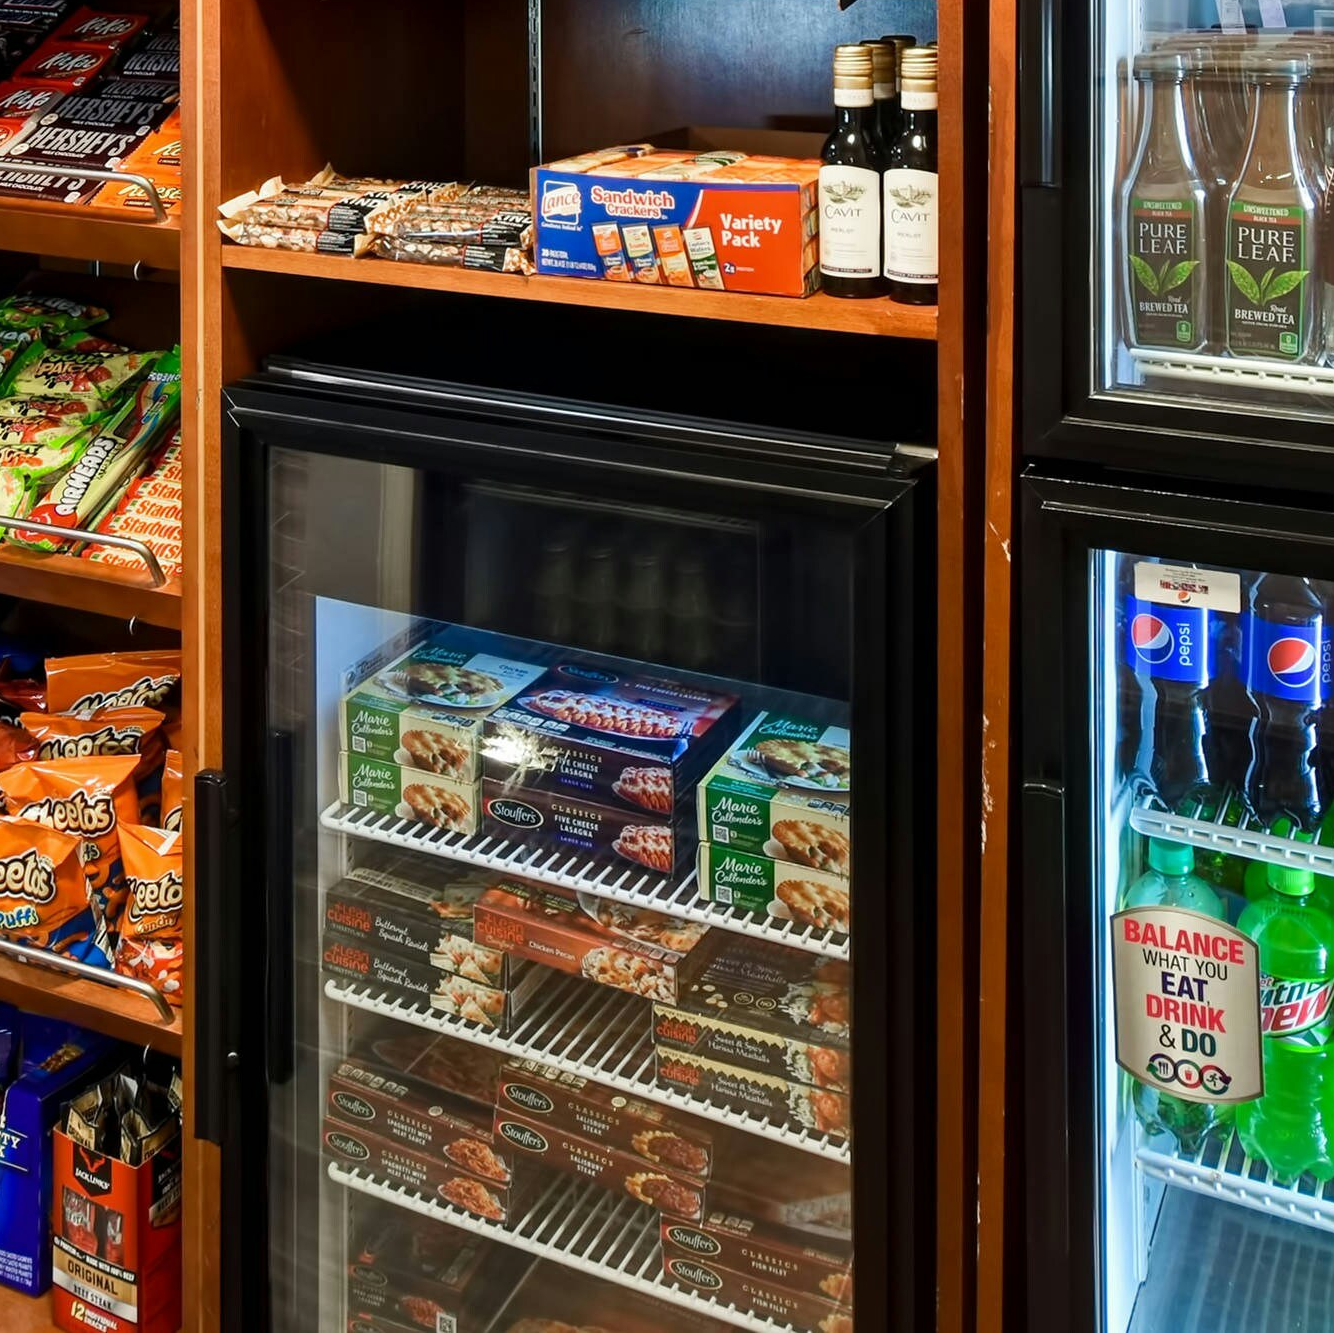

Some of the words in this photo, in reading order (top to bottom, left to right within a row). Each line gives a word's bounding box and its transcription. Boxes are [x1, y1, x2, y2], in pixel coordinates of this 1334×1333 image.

[27, 127, 136, 157] HERSHEY'S
[543, 187, 580, 214] Lance
[592, 187, 674, 209] Sandwich
[1143, 200, 1183, 210] UNSWEETENED
[607, 204, 660, 218] Crackers
[825, 204, 861, 219] CAVIT
[892, 208, 930, 223] CAVIT
[1243, 205, 1289, 217] UNSWEETENED
[720, 213, 782, 234] Variety
[1139, 222, 1187, 238] PURE
[722, 231, 760, 247] Pack
[1238, 226, 1295, 246] PURE
[1139, 238, 1185, 254] LEAF
[1238, 243, 1292, 262] LEAF
[1139, 302, 1171, 313] BREWED
[1172, 304, 1188, 314] TEA
[1234, 308, 1273, 321] BREWED
[1274, 312, 1295, 324] TEA
[1176, 622, 1193, 666] pepsi
[1321, 639, 1331, 683] pepsi
[353, 710, 391, 727] Marie
[353, 765, 393, 781] Marie
[560, 767, 593, 780] LASAGNA
[551, 804, 603, 821] CLASSICS
[712, 796, 760, 814] Marie
[555, 814, 570, 825] FIVE
[572, 819, 599, 832] CHEESE
[560, 825, 593, 839] LASAGNA
[715, 856, 764, 875] Marie
[375, 917, 408, 935] Butternut
[379, 929, 404, 945] Squash
[405, 937, 429, 952] Ravioli
[1123, 918, 1245, 965] BALANCE
[529, 941, 554, 954] Chicken
[555, 948, 576, 961] Pecan
[373, 958, 407, 977] Butternut
[1142, 948, 1190, 972] WHAT
[1195, 958, 1228, 981] YOU
[1161, 971, 1211, 1005] EAT,
[1146, 994, 1227, 1034] DRINK
[1159, 1024, 1176, 1049] &
[1181, 1029, 1216, 1058] DO
[708, 1041, 735, 1055] Harissa
[737, 1047, 770, 1063] Meatballs
[740, 1090, 772, 1107] Meatballs
[387, 1109, 433, 1133] CLASSICS
[568, 1102, 620, 1125] CLASSICS
[575, 1114, 610, 1131] SALISBURY
[582, 1124, 603, 1136] STEAK
[381, 1150, 427, 1172] CLASSICS
[562, 1142, 614, 1167] CLASSICS
[570, 1154, 604, 1172] SALISBURY
[577, 1165, 596, 1177] STEAK
[742, 1248, 798, 1271] CLASSICS
[68, 1260, 118, 1295] ORIGINAL
[73, 1284, 89, 1299] BEEF
[91, 1293, 112, 1310] STEAK
[742, 1284, 799, 1309] CLASSICS
[71, 1300, 86, 1322] 12
